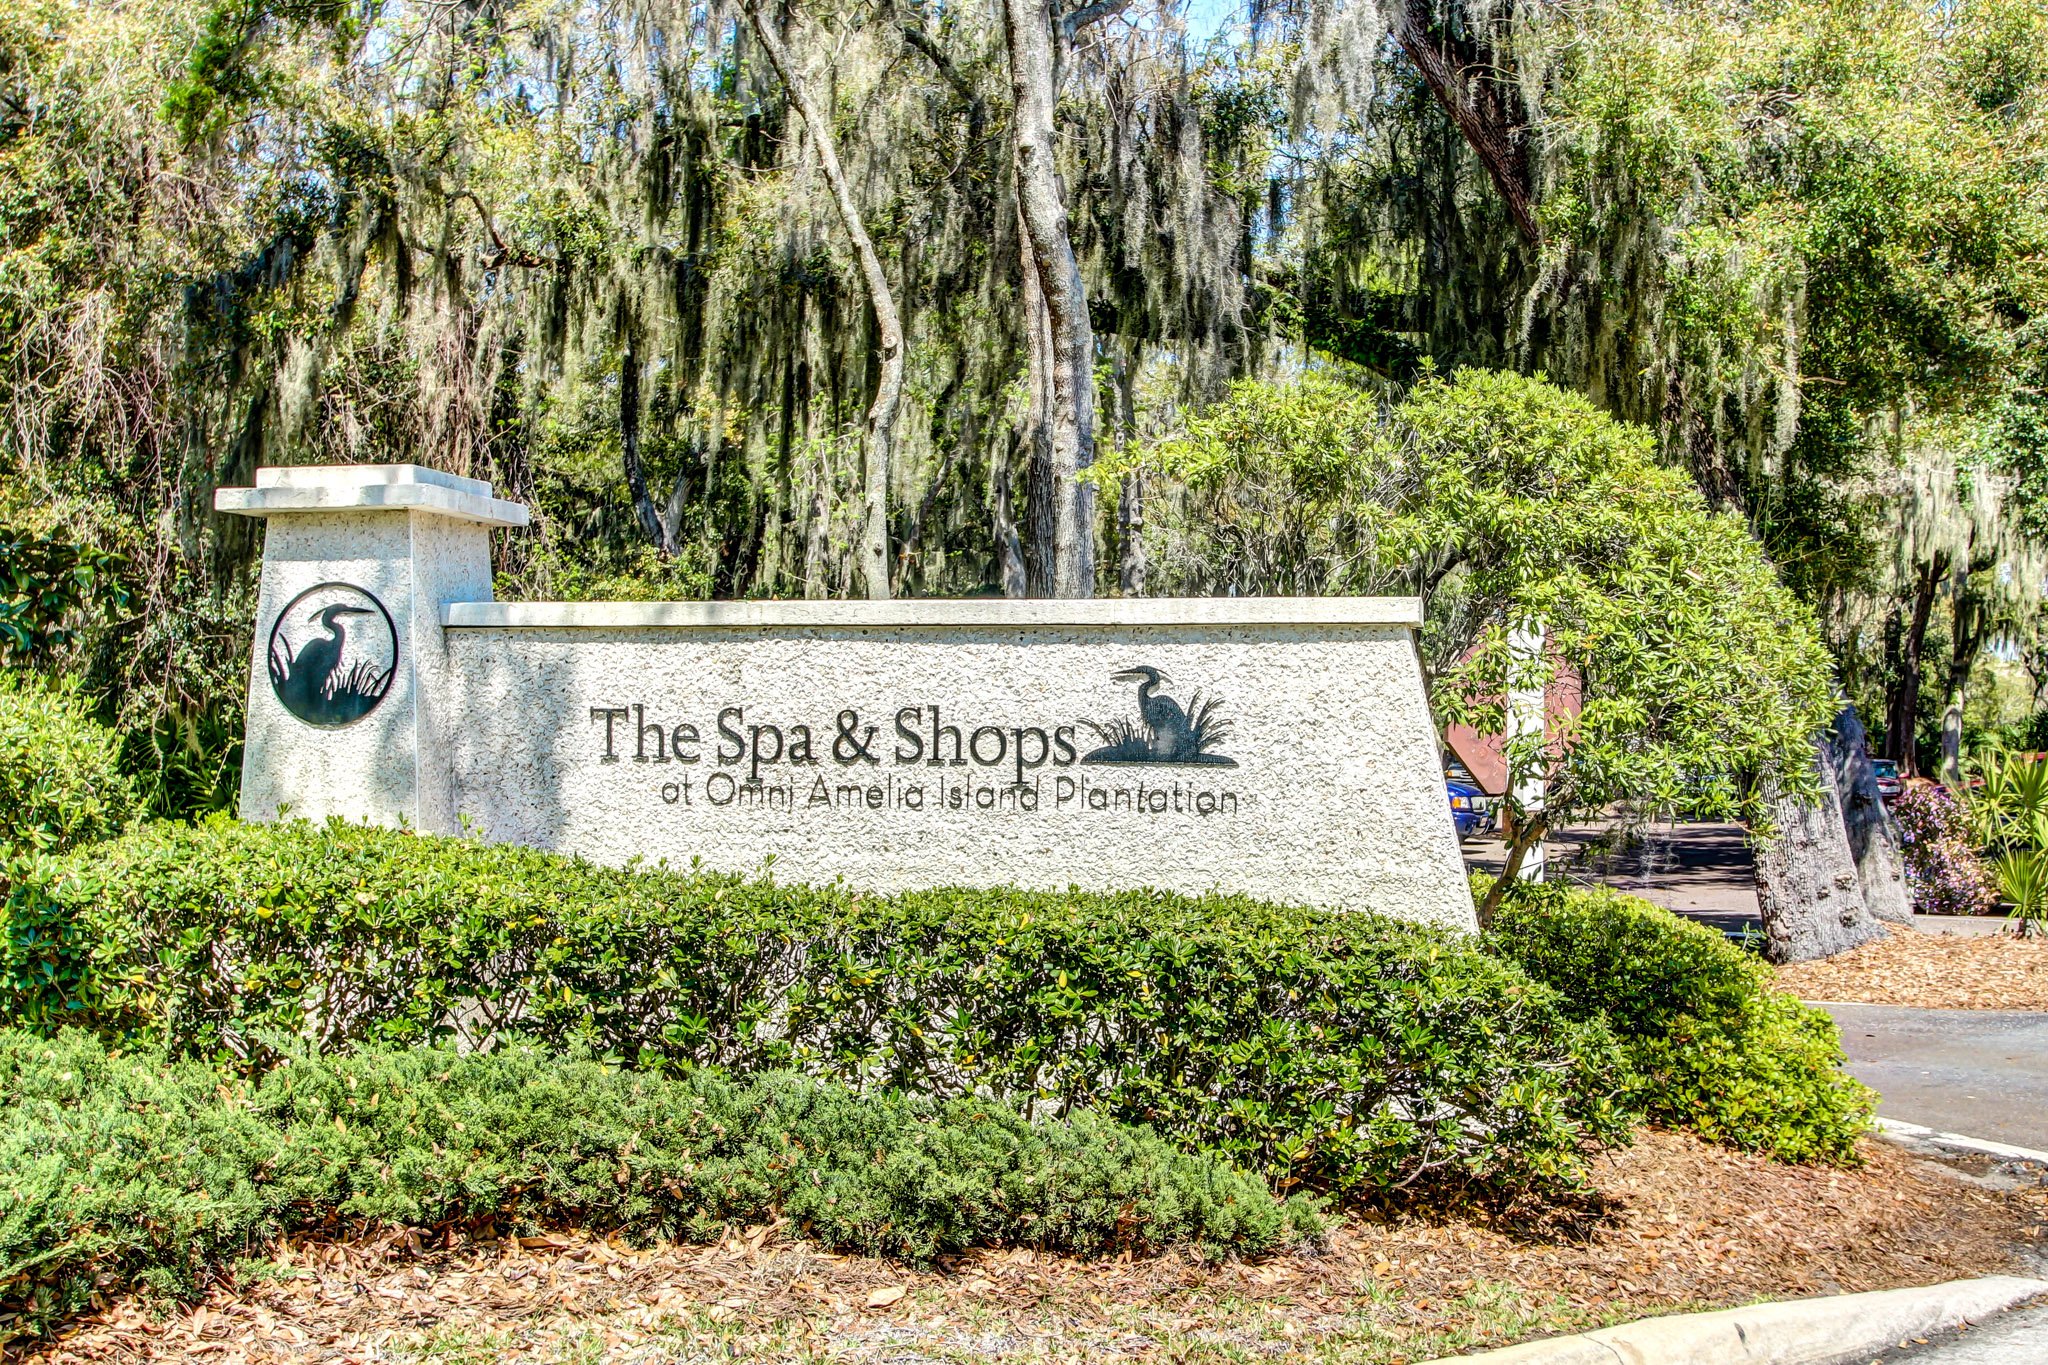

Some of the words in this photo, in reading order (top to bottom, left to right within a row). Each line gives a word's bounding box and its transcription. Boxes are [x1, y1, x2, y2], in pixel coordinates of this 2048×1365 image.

[590, 704, 701, 765] The
[717, 707, 820, 784] Spa
[832, 709, 881, 767] &
[895, 705, 1077, 787] Shops
[661, 775, 695, 806] at
[706, 771, 793, 810] Omni
[807, 774, 925, 810] Amelia
[941, 775, 1040, 811] Island
[1056, 776, 1238, 817] Plantation
